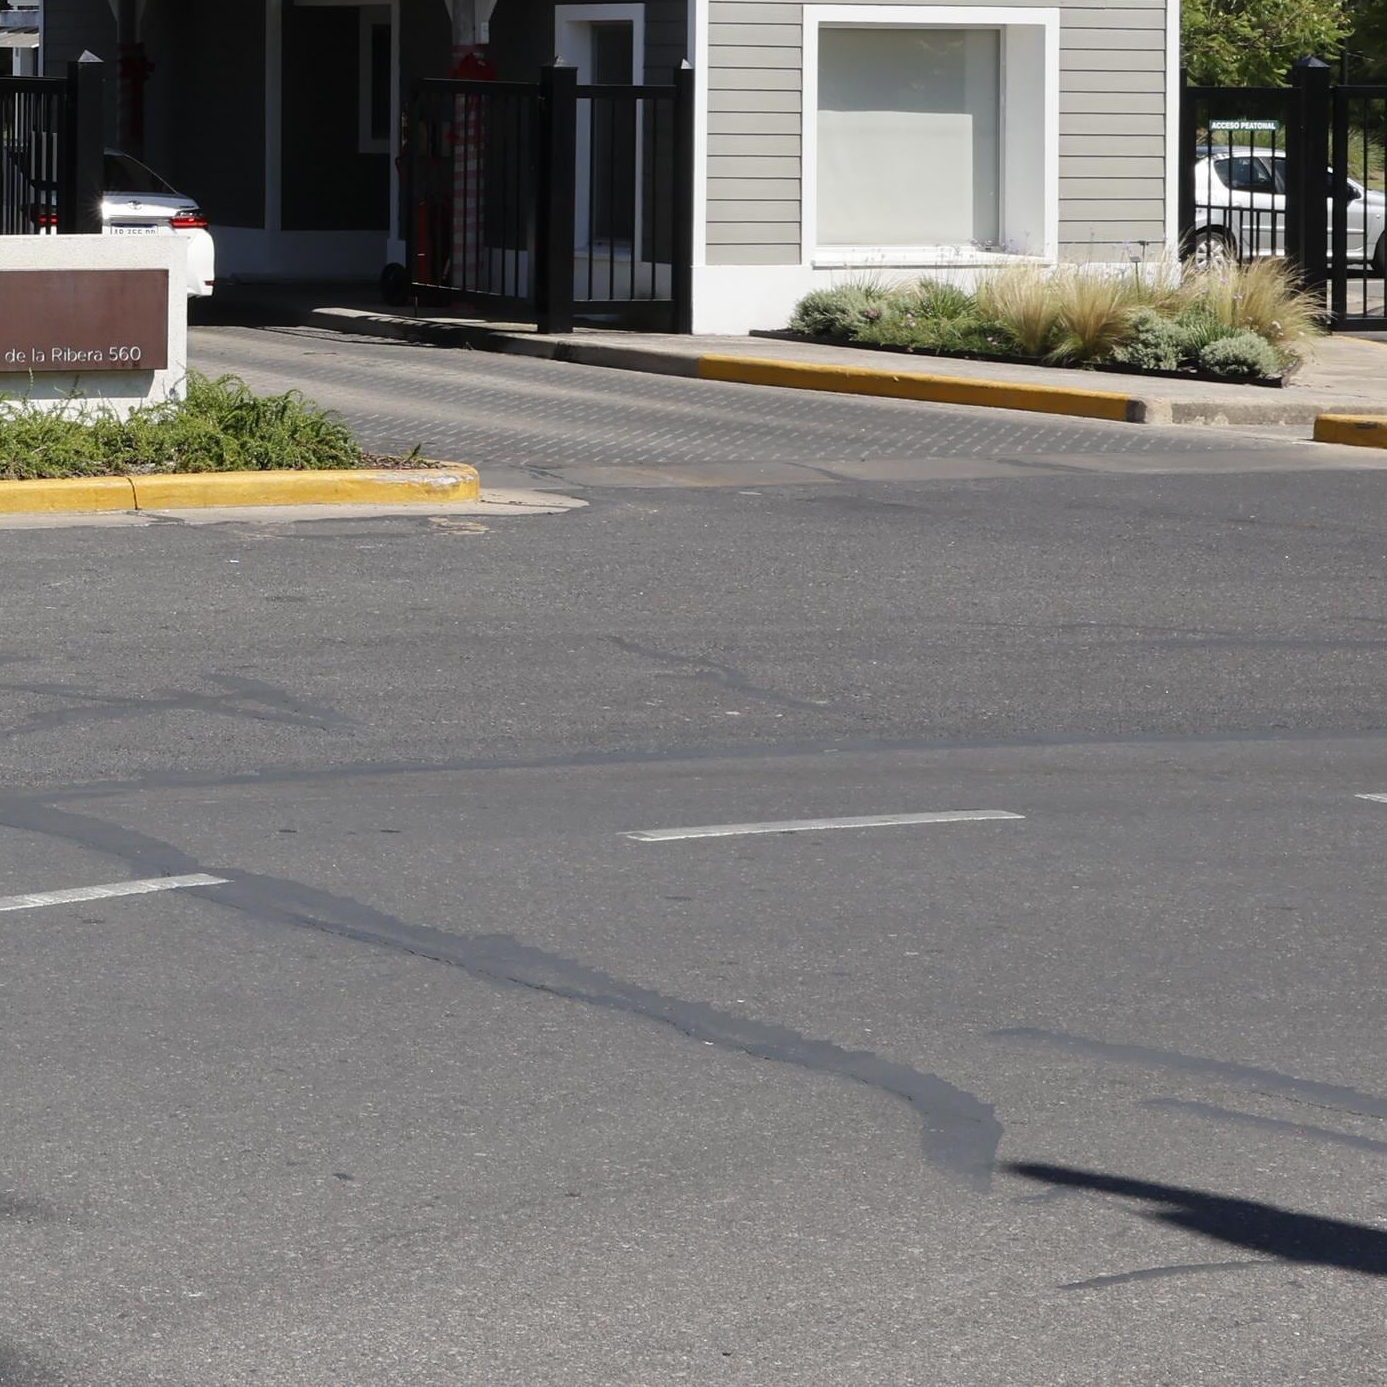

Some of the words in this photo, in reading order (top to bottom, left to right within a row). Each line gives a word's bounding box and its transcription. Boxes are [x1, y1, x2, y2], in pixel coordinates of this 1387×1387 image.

[1211, 121, 1240, 129] ACCESO
[1240, 121, 1276, 130] PEATONAL
[5, 348, 26, 363] de
[32, 348, 45, 363] la
[51, 347, 103, 362] Ribera
[109, 346, 141, 361] 560
